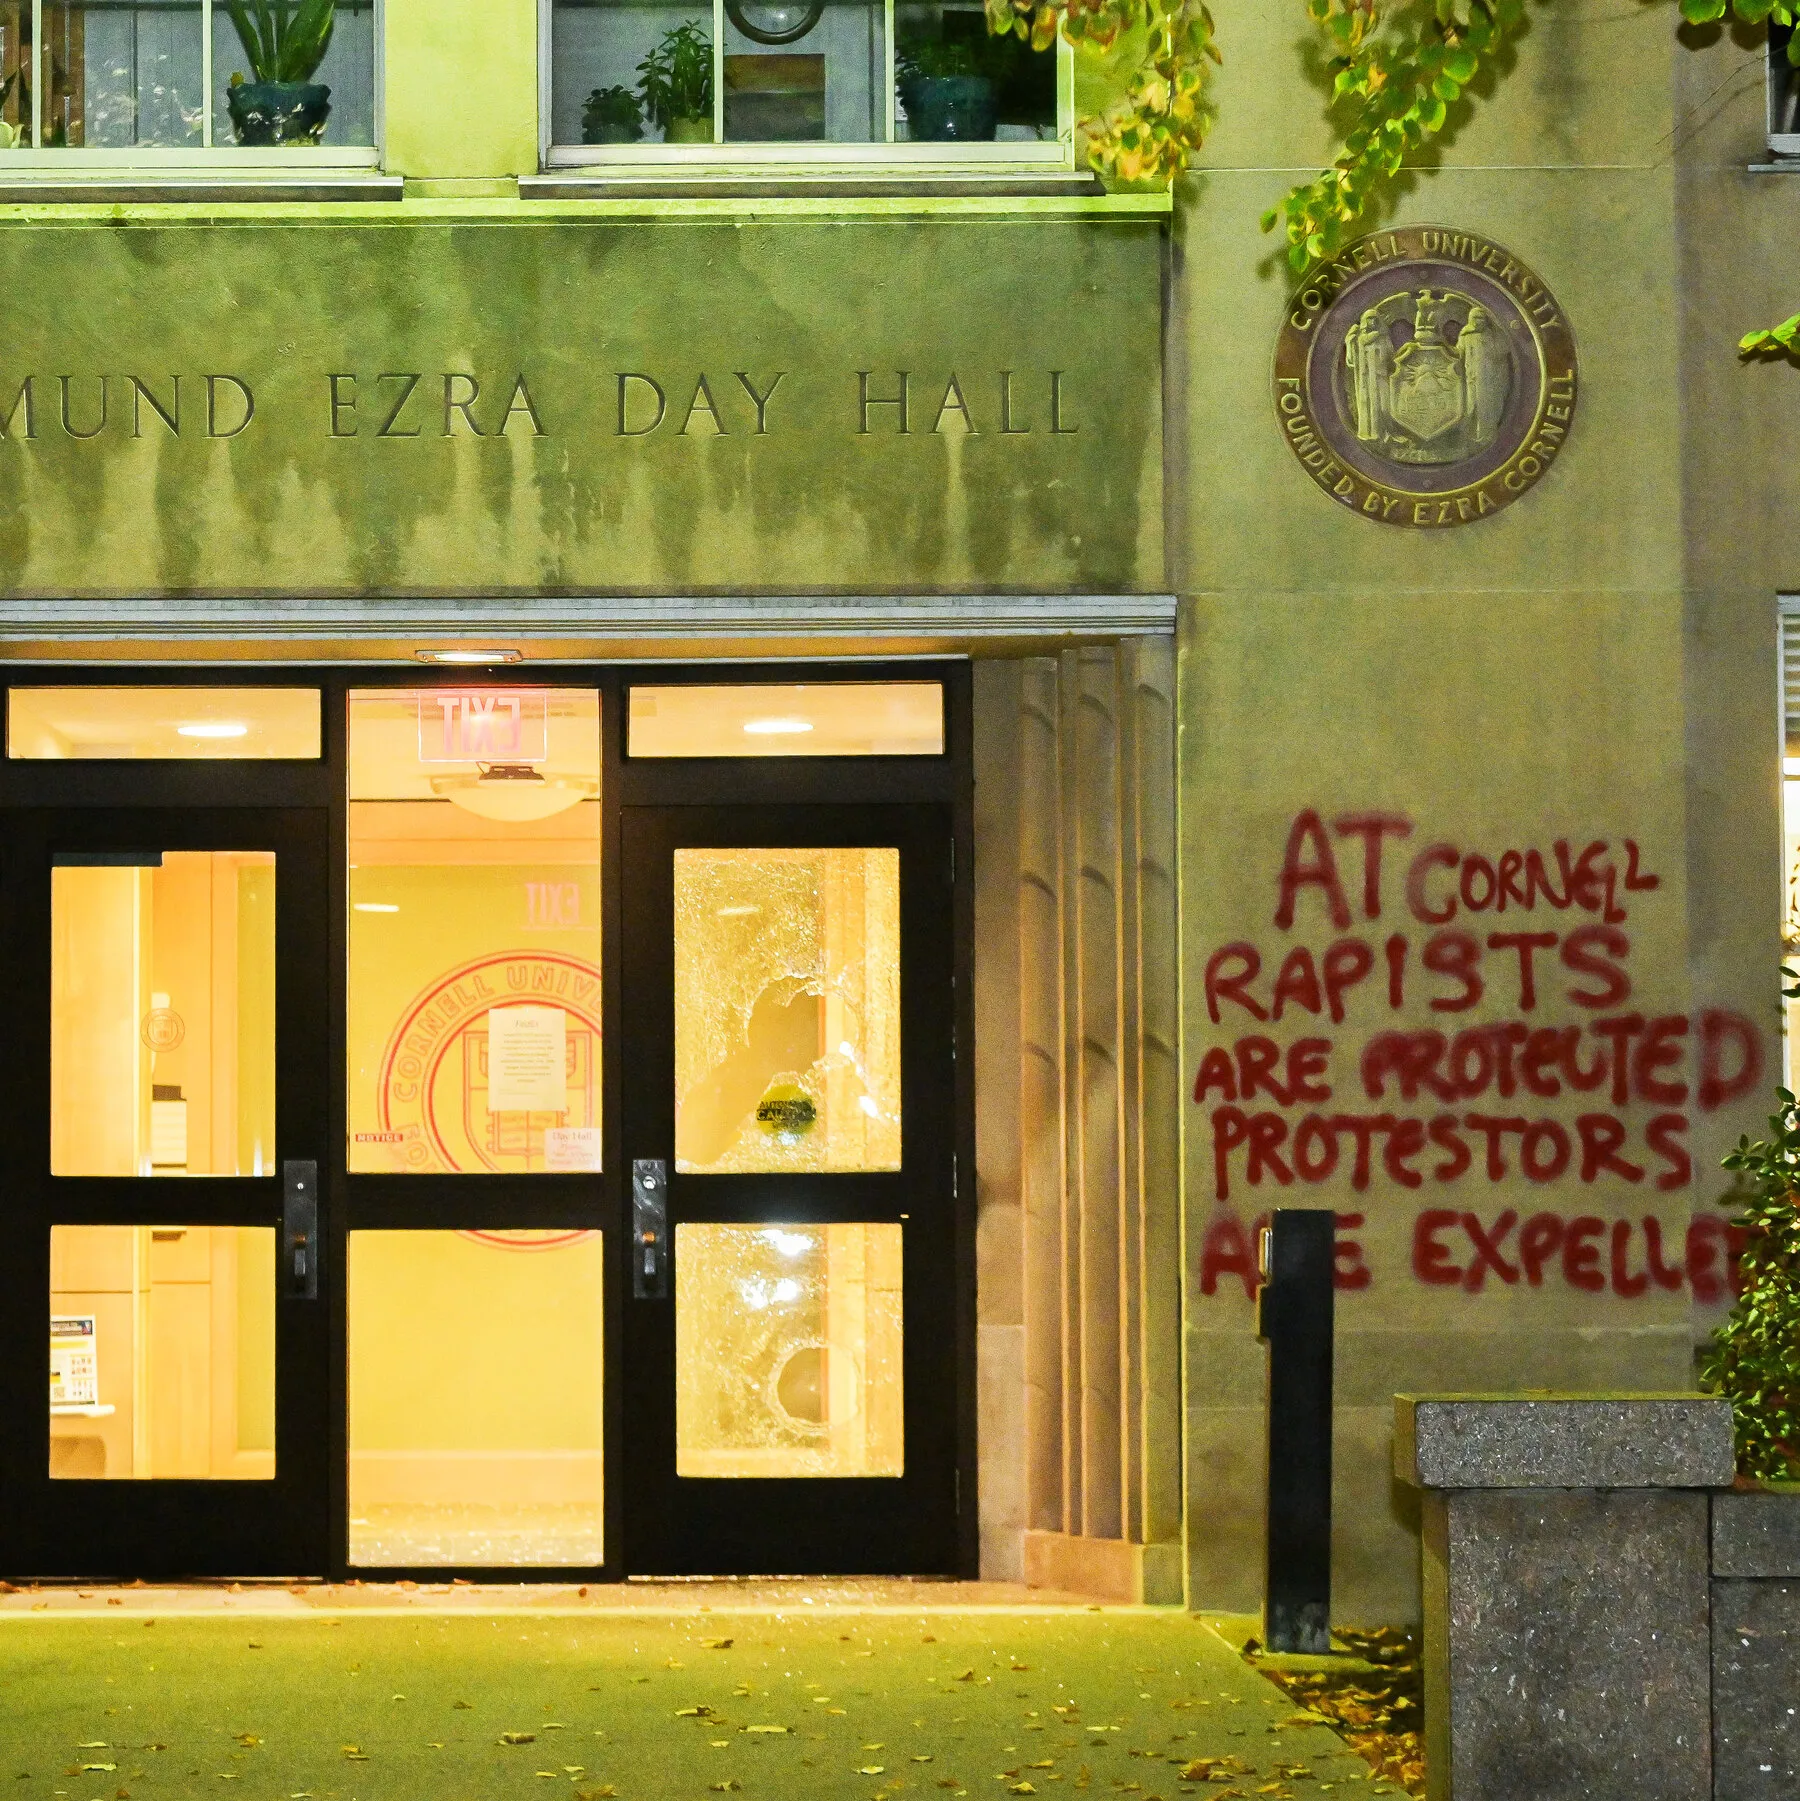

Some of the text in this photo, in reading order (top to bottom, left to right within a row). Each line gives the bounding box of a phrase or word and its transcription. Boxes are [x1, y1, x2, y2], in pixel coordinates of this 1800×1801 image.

[1290, 231, 1562, 332] CORNELL UNIVERSITY
[325, 372, 549, 438] EZRA
[613, 371, 788, 437] DAY
[854, 370, 1081, 436] HALL
[1278, 368, 1575, 525] FOUNDED BY EZRA CORNELL
[1273, 808, 1413, 930] AT
[1204, 924, 1633, 1024] RAPISTS
[392, 974, 496, 1103] CORNELL
[1194, 1008, 1766, 1113] ARE PROTECTED
[1210, 1104, 1692, 1200] PROTESTORS
[1199, 1207, 1372, 1299] AE
